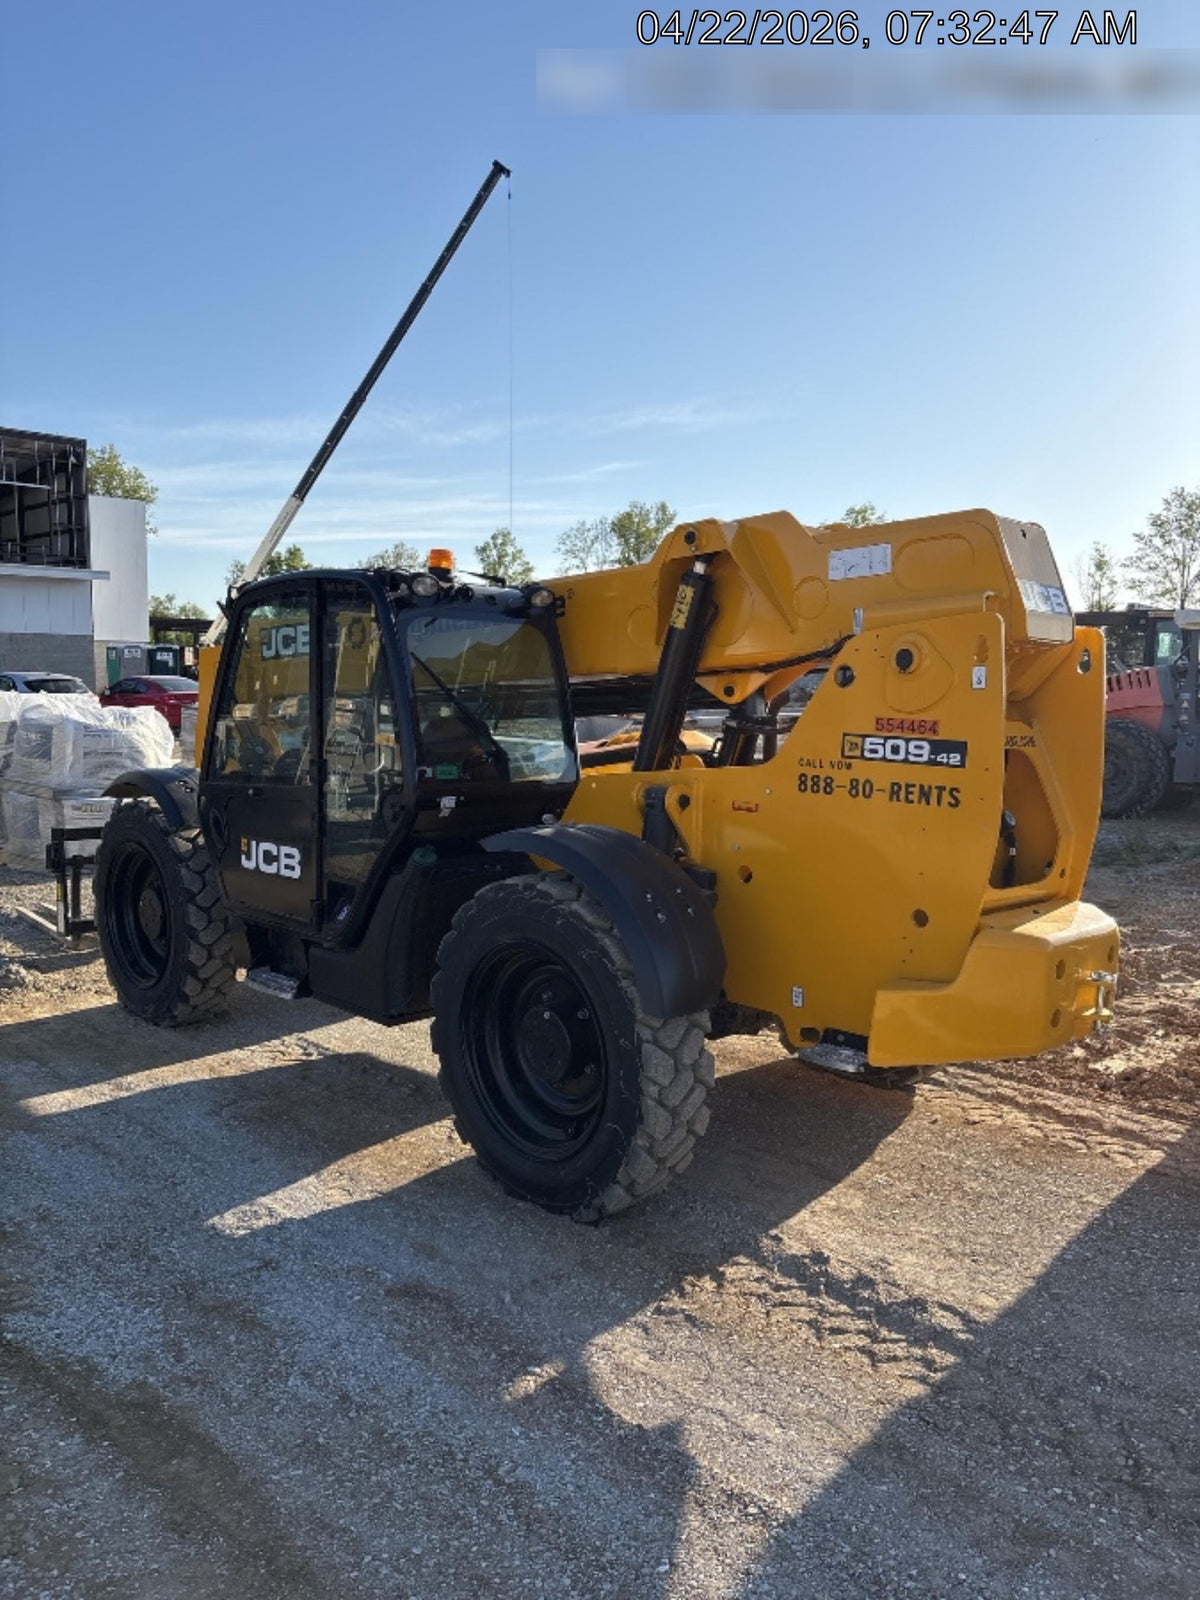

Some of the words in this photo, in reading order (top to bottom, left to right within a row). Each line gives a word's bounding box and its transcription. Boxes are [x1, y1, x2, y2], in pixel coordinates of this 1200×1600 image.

[875, 718, 939, 735] 554464
[798, 758, 824, 769] CALL
[830, 760, 853, 770] NOW
[863, 737, 961, 765] 509-42
[797, 773, 961, 808] 888-80-RENTS
[241, 840, 301, 879] JCB
